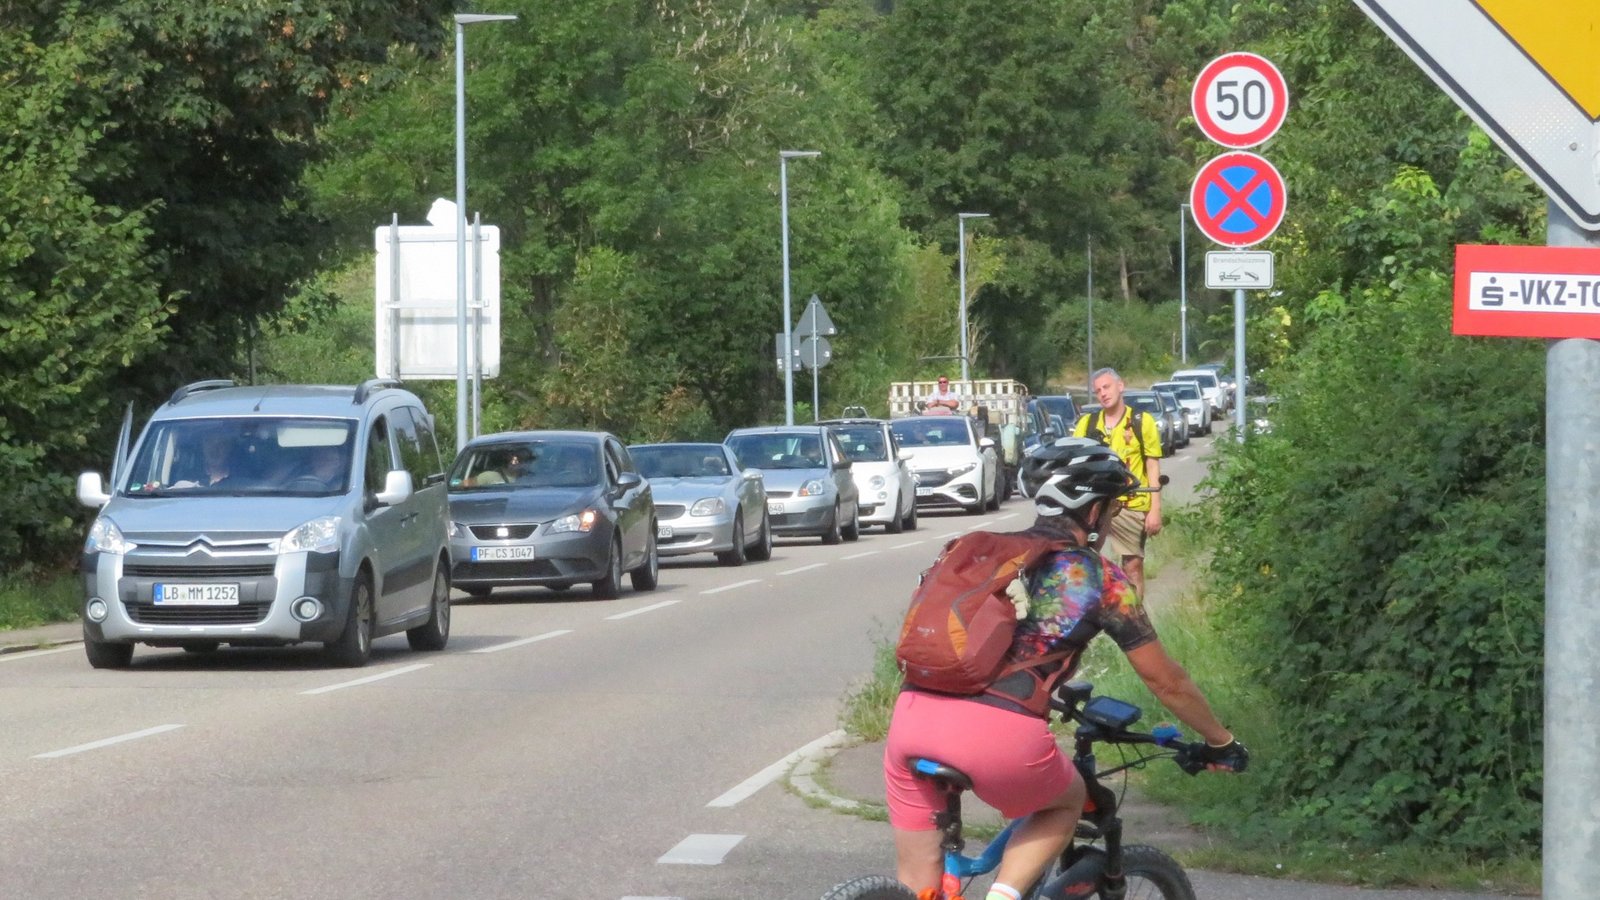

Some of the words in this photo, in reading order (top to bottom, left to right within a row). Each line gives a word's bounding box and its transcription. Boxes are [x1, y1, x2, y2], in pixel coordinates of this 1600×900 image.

[1216, 80, 1266, 121] 50
[478, 548, 490, 559] PF
[495, 548, 508, 559] CS
[510, 547, 532, 558] 1047
[163, 586, 179, 600] LB
[188, 586, 204, 600] MM
[206, 586, 237, 600] 1252
